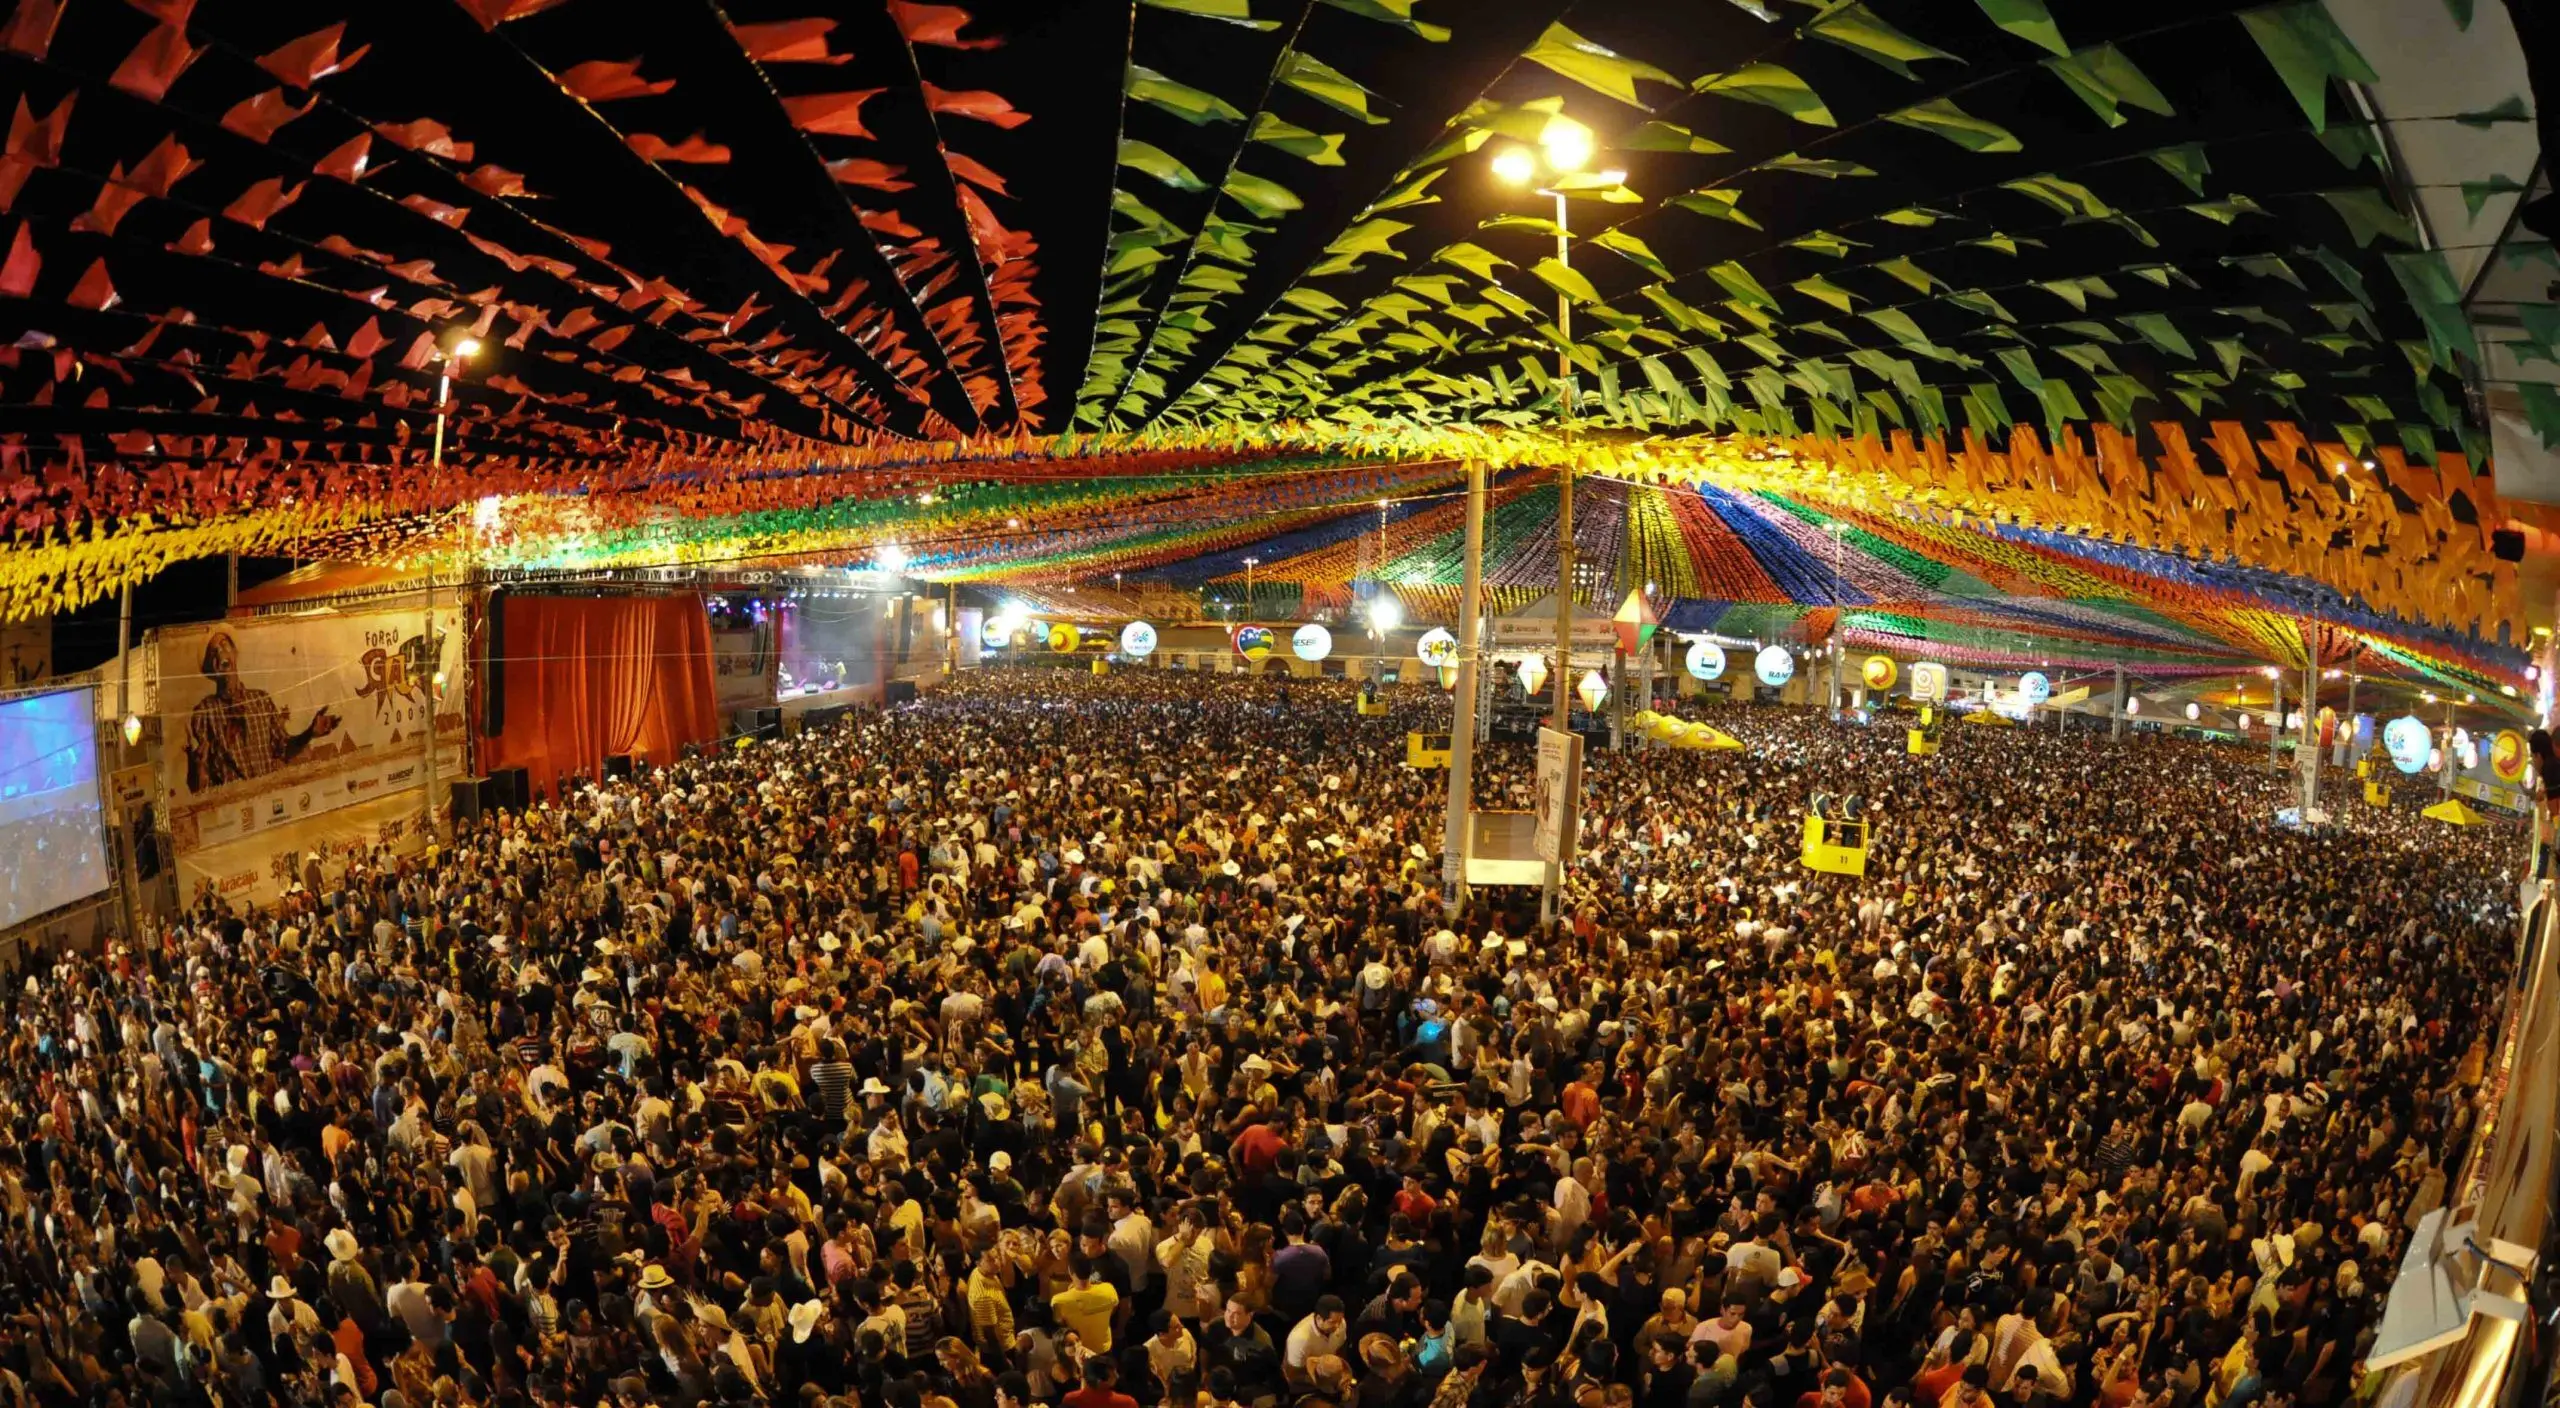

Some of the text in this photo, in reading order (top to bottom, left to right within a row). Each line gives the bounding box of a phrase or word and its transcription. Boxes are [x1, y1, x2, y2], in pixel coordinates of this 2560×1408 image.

[365, 626, 399, 648] FORRÓ
[383, 705, 426, 726] 2009
[219, 868, 259, 894] Aracaju
